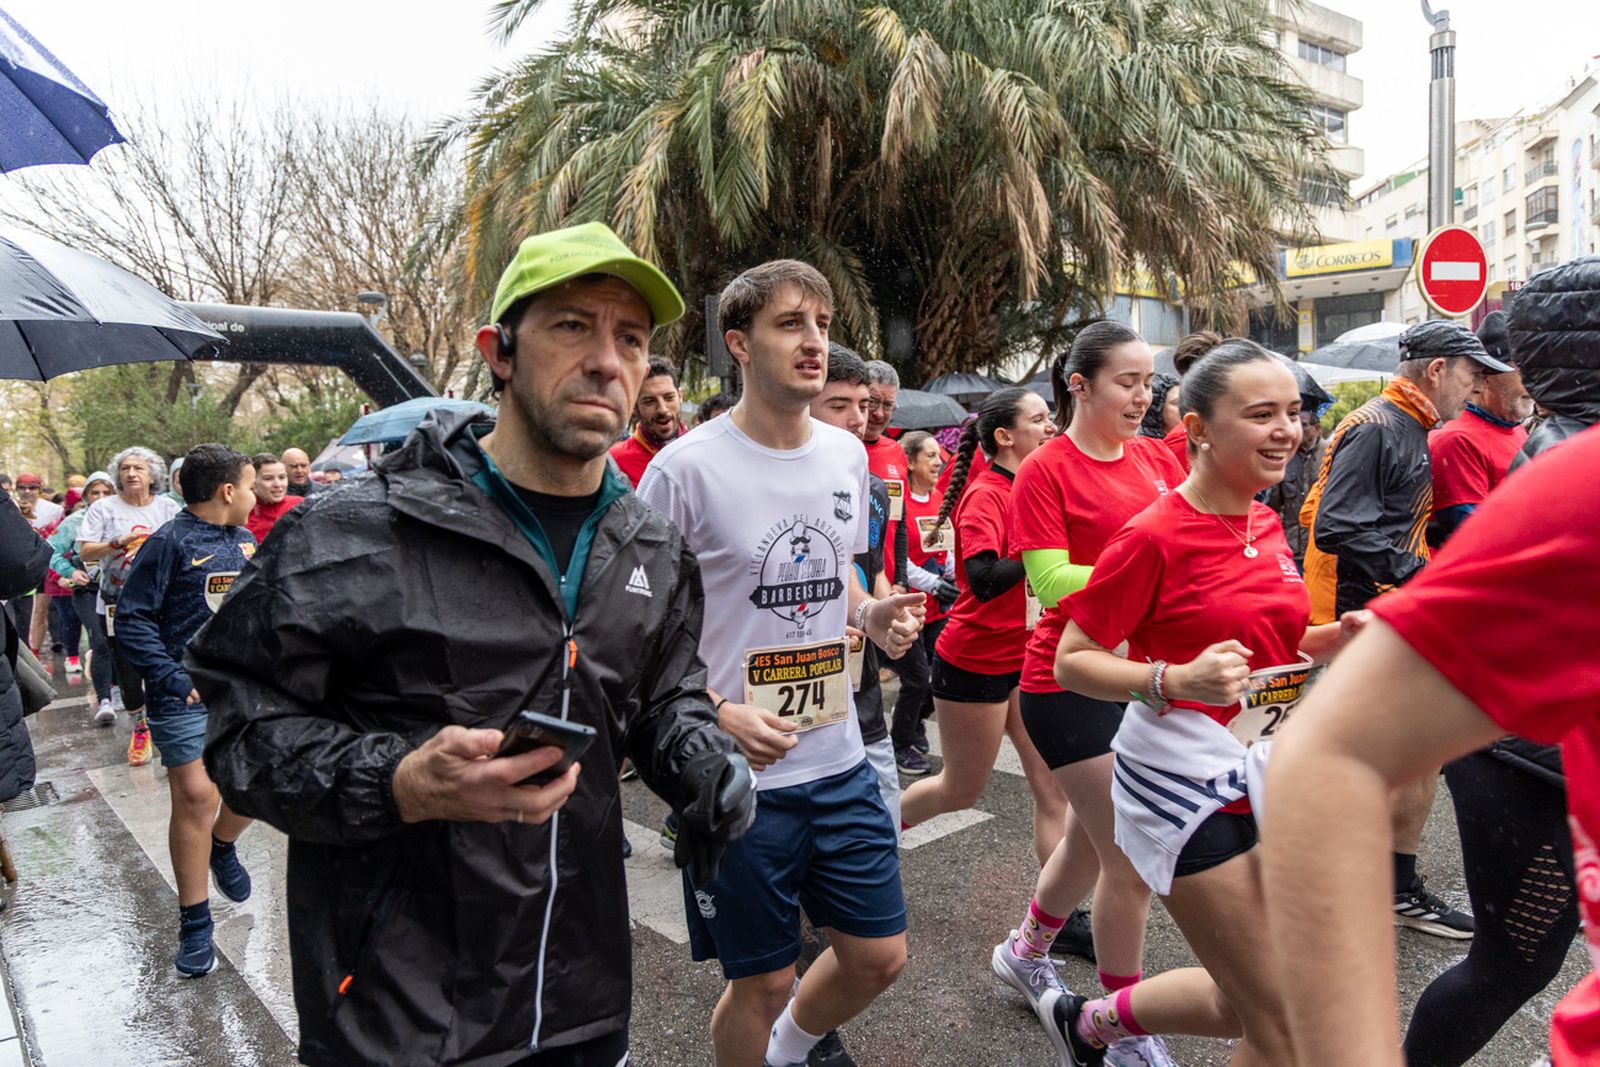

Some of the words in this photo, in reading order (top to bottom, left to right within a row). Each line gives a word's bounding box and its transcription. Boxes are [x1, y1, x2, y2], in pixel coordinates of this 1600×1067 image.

[230, 322, 245, 332] de
[755, 655, 771, 668] IES
[773, 654, 793, 666] San
[795, 651, 817, 664] Juan
[817, 647, 840, 659] Bosco
[752, 670, 760, 682] V
[763, 665, 807, 682] CARRERA
[809, 658, 842, 676] POPULAR
[1268, 676, 1288, 688] San
[778, 680, 825, 717] 274
[1249, 693, 1257, 706] V
